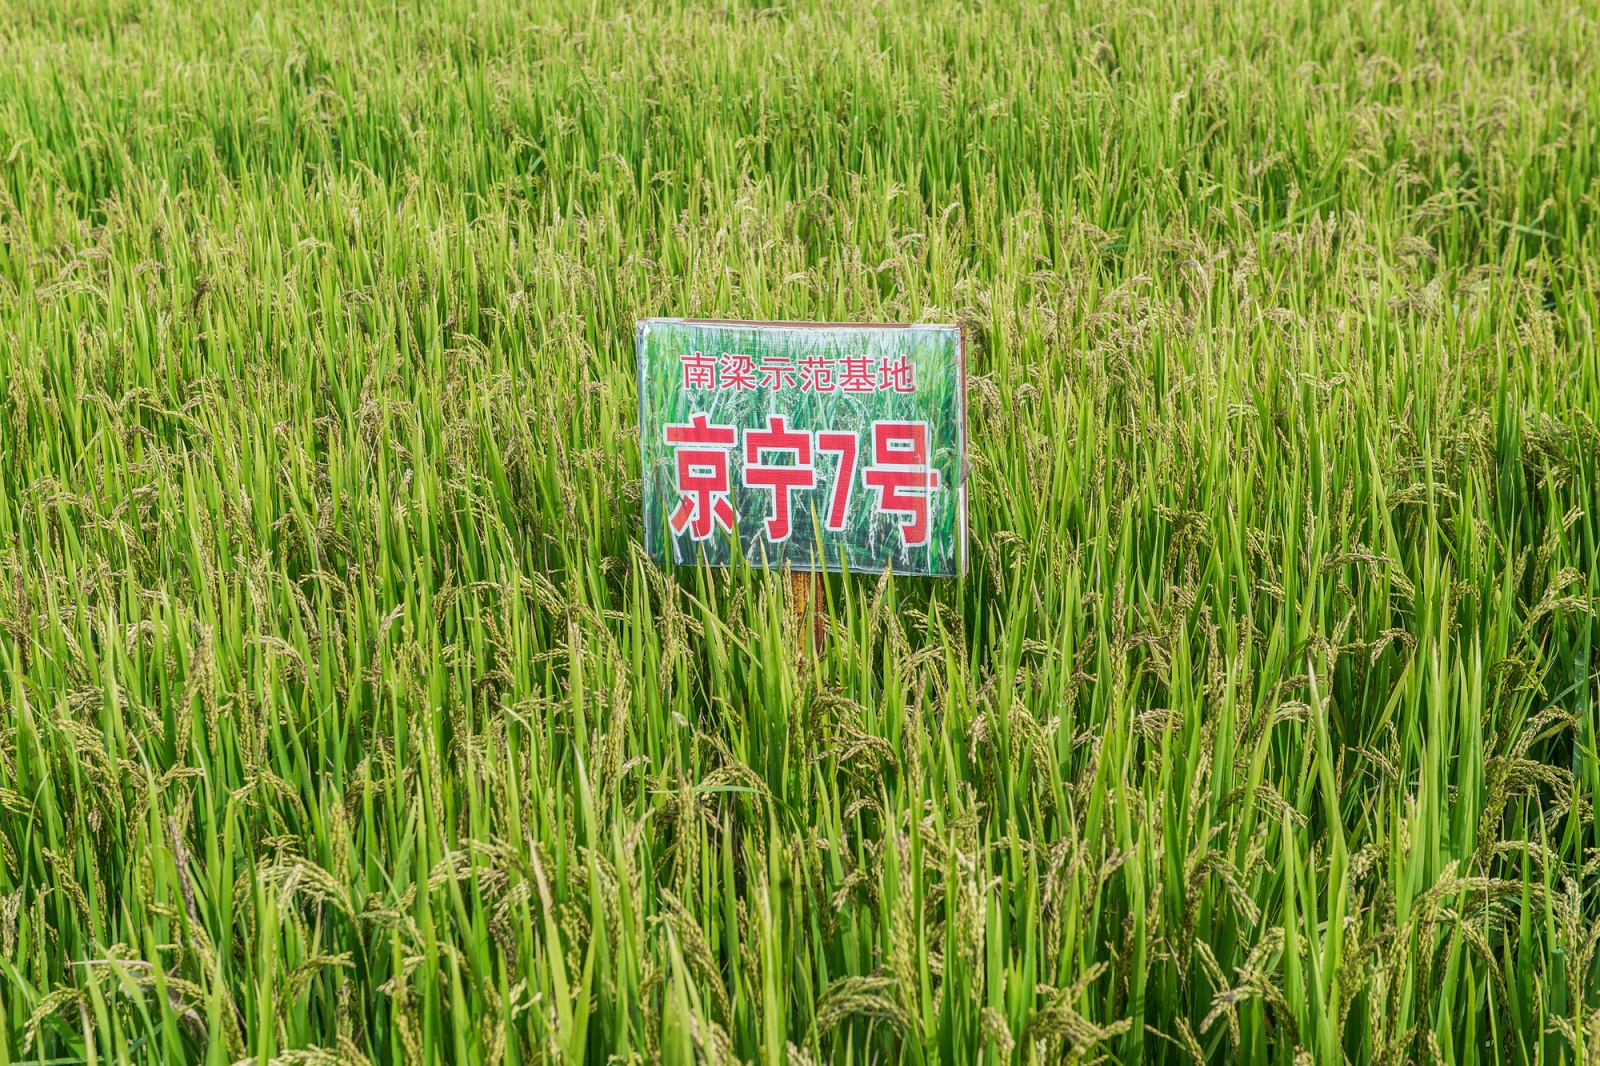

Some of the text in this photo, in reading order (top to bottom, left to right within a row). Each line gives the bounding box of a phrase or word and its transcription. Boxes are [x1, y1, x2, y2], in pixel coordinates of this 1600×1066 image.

[681, 352, 917, 393] 南梁示范基地
[664, 414, 940, 547] 京宁7号
